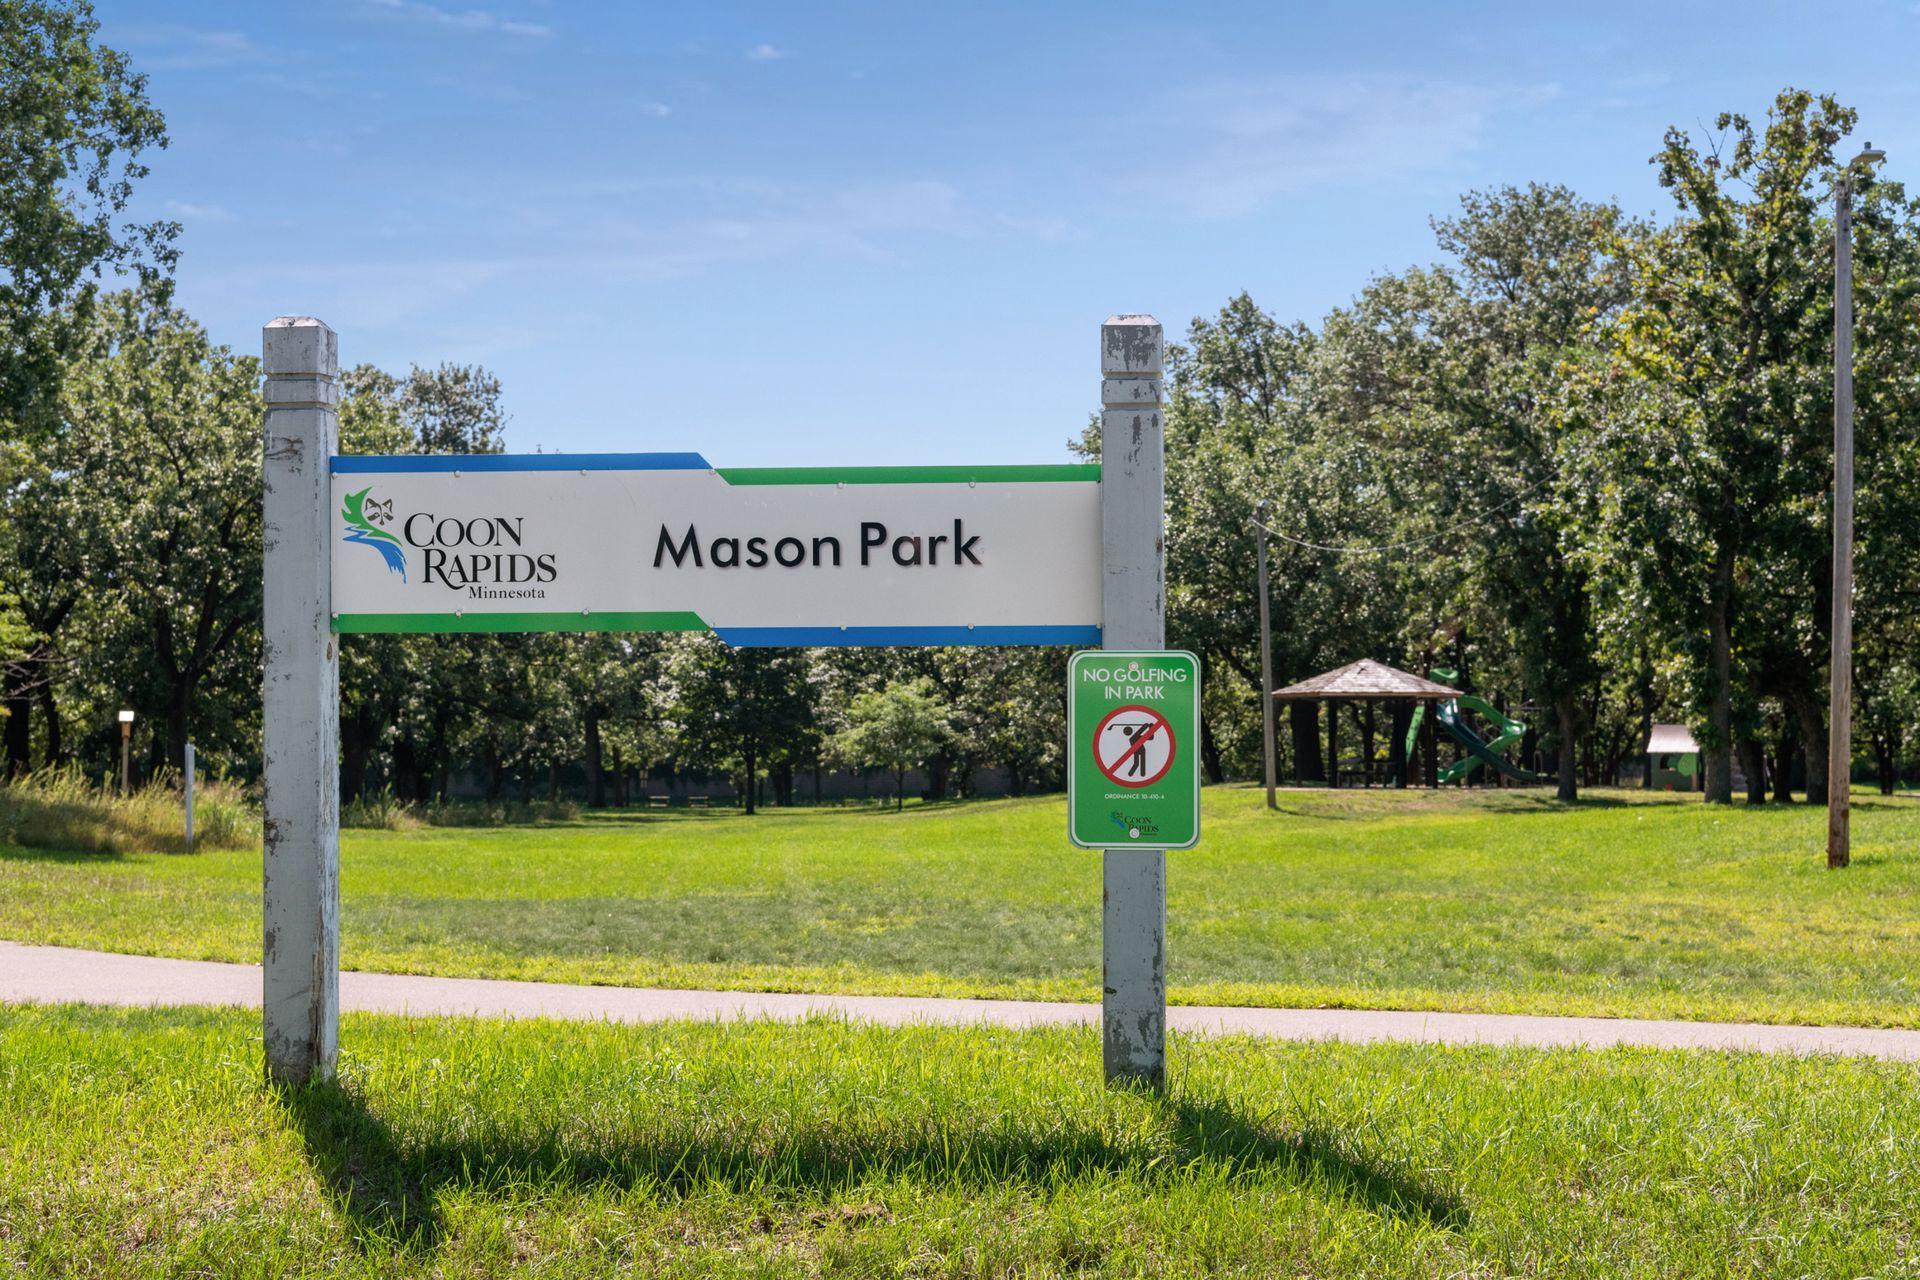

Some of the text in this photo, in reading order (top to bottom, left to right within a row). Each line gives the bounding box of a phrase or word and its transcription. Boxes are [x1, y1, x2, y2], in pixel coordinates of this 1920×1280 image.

[404, 512, 524, 548] COON
[653, 518, 982, 568] Mason Park
[422, 548, 558, 591] RAPIDS
[468, 586, 546, 600] Minnesota
[1083, 668, 1187, 682] NO GOLFING
[1104, 686, 1165, 700] IN PARK
[1124, 816, 1152, 824] COON
